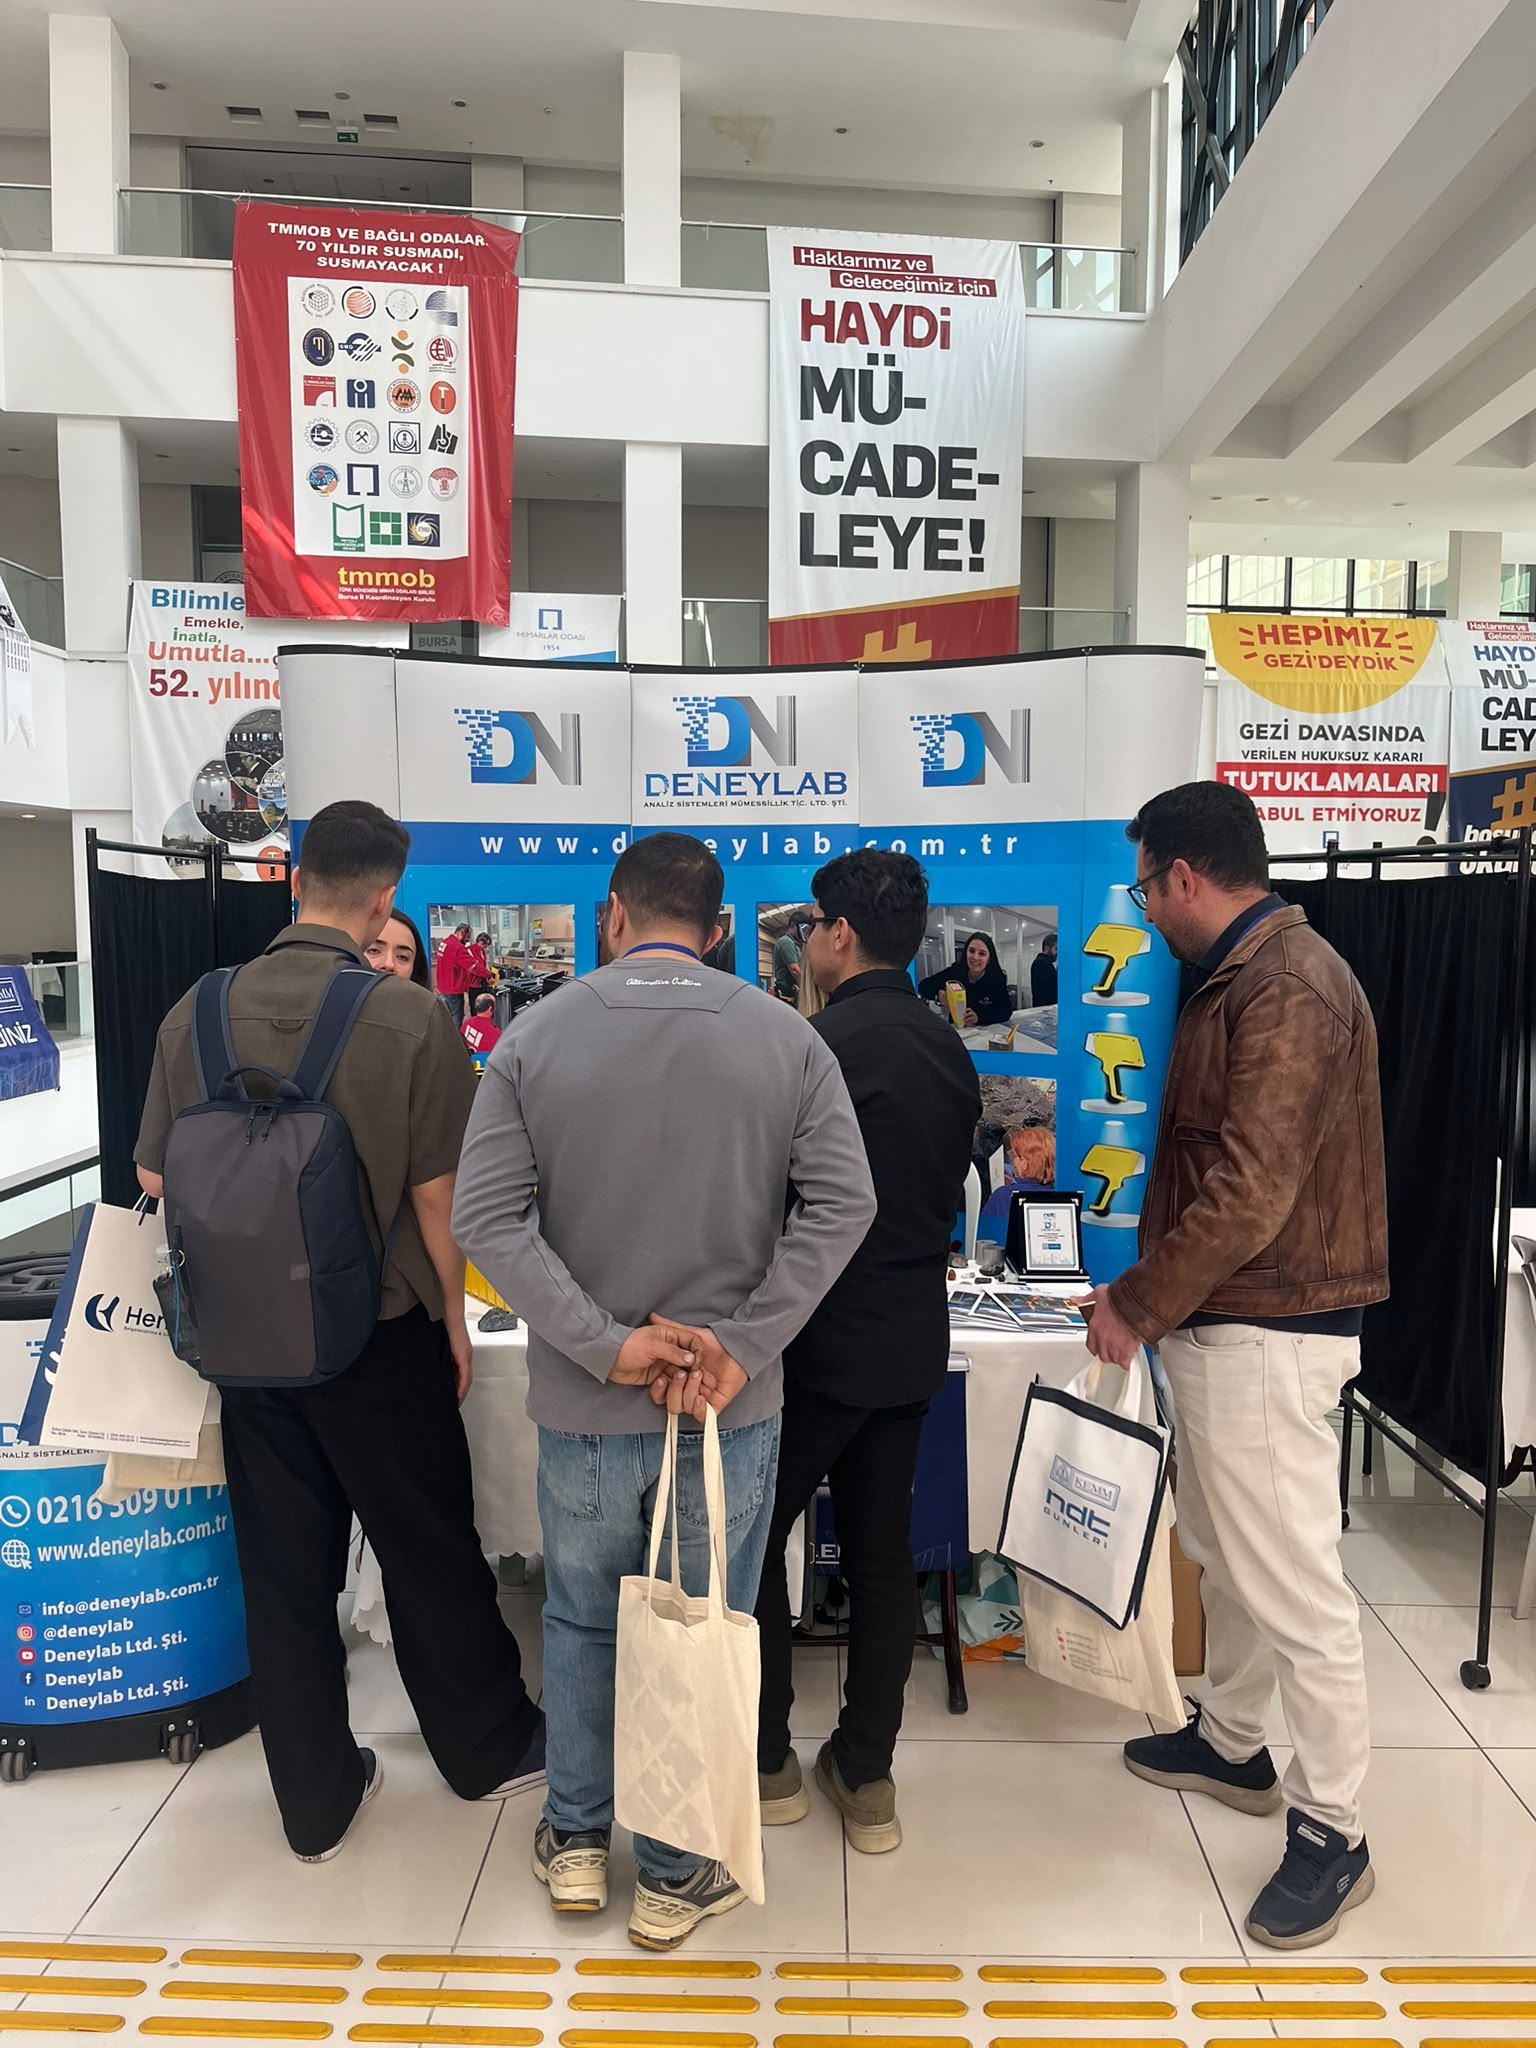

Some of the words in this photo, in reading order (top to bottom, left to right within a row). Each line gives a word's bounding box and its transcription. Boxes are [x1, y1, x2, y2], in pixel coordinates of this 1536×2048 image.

[268, 222, 332, 238] TMMOB
[337, 228, 359, 240] VE
[364, 229, 414, 243] BAĞLI
[420, 233, 489, 247] ODALAR
[296, 240, 316, 251] 70
[322, 242, 378, 256] YILDIR
[800, 248, 902, 271] Haklarımız
[905, 259, 927, 271] ve
[317, 256, 433, 273] SUSMAYACAK
[839, 272, 955, 293] Geleceğimiz
[958, 279, 990, 296] için
[800, 352, 926, 426] MÜ-
[800, 439, 1000, 501] CADE-
[799, 512, 985, 573] LEYE!
[337, 566, 436, 588] tmmob
[365, 594, 412, 603] Koordinasyon
[184, 616, 244, 630] Emekle,
[1257, 618, 1392, 649] HEPİMİZ
[1469, 622, 1516, 631] Haklarımız
[419, 637, 456, 648] BURSA
[516, 630, 558, 640] MİMARLAR
[561, 632, 586, 641] ODASI
[148, 641, 269, 664] Umutla...
[1263, 650, 1399, 671] GEZİ'DEYDİK
[1473, 645, 1536, 662] HAYD
[149, 669, 199, 698] 52.
[1239, 718, 1289, 741] GEZİ
[1298, 724, 1426, 743] DAVASINDA
[1241, 747, 1297, 761] VERİLEN
[1301, 750, 1370, 762] HUKUKSUZ
[1374, 752, 1423, 763] KARARI
[644, 771, 848, 797] DENEYLAB
[1223, 770, 1439, 793] TUTUKLAMALARI
[643, 800, 674, 808] ANALİZ
[676, 800, 728, 808] SİSTEMLERİ
[730, 799, 789, 807] MÜMESSİLLİK
[791, 799, 808, 807] TİC.
[810, 799, 829, 807] LTD.
[831, 799, 848, 808] ŞTİ.
[1256, 806, 1304, 822] ABUL
[1312, 803, 1422, 823] ETMİYORUZ
[480, 831, 1018, 861] www.deylab.com.tr
[36, 1494, 103, 1525] 0216
[1046, 1488, 1110, 1538] ndt
[37, 1514, 228, 1562] www.deneylab.com.tr
[42, 1575, 219, 1616] info@deneylab.com.tr
[43, 1617, 134, 1640] @deneylab
[44, 1641, 122, 1663] Deneylab
[126, 1637, 158, 1654] Ltd.
[161, 1630, 188, 1650] Şti.
[45, 1666, 123, 1687] Deneylab
[46, 1687, 124, 1710] Deneylab
[128, 1683, 159, 1700] Ltd.
[162, 1677, 189, 1696] Şti.
